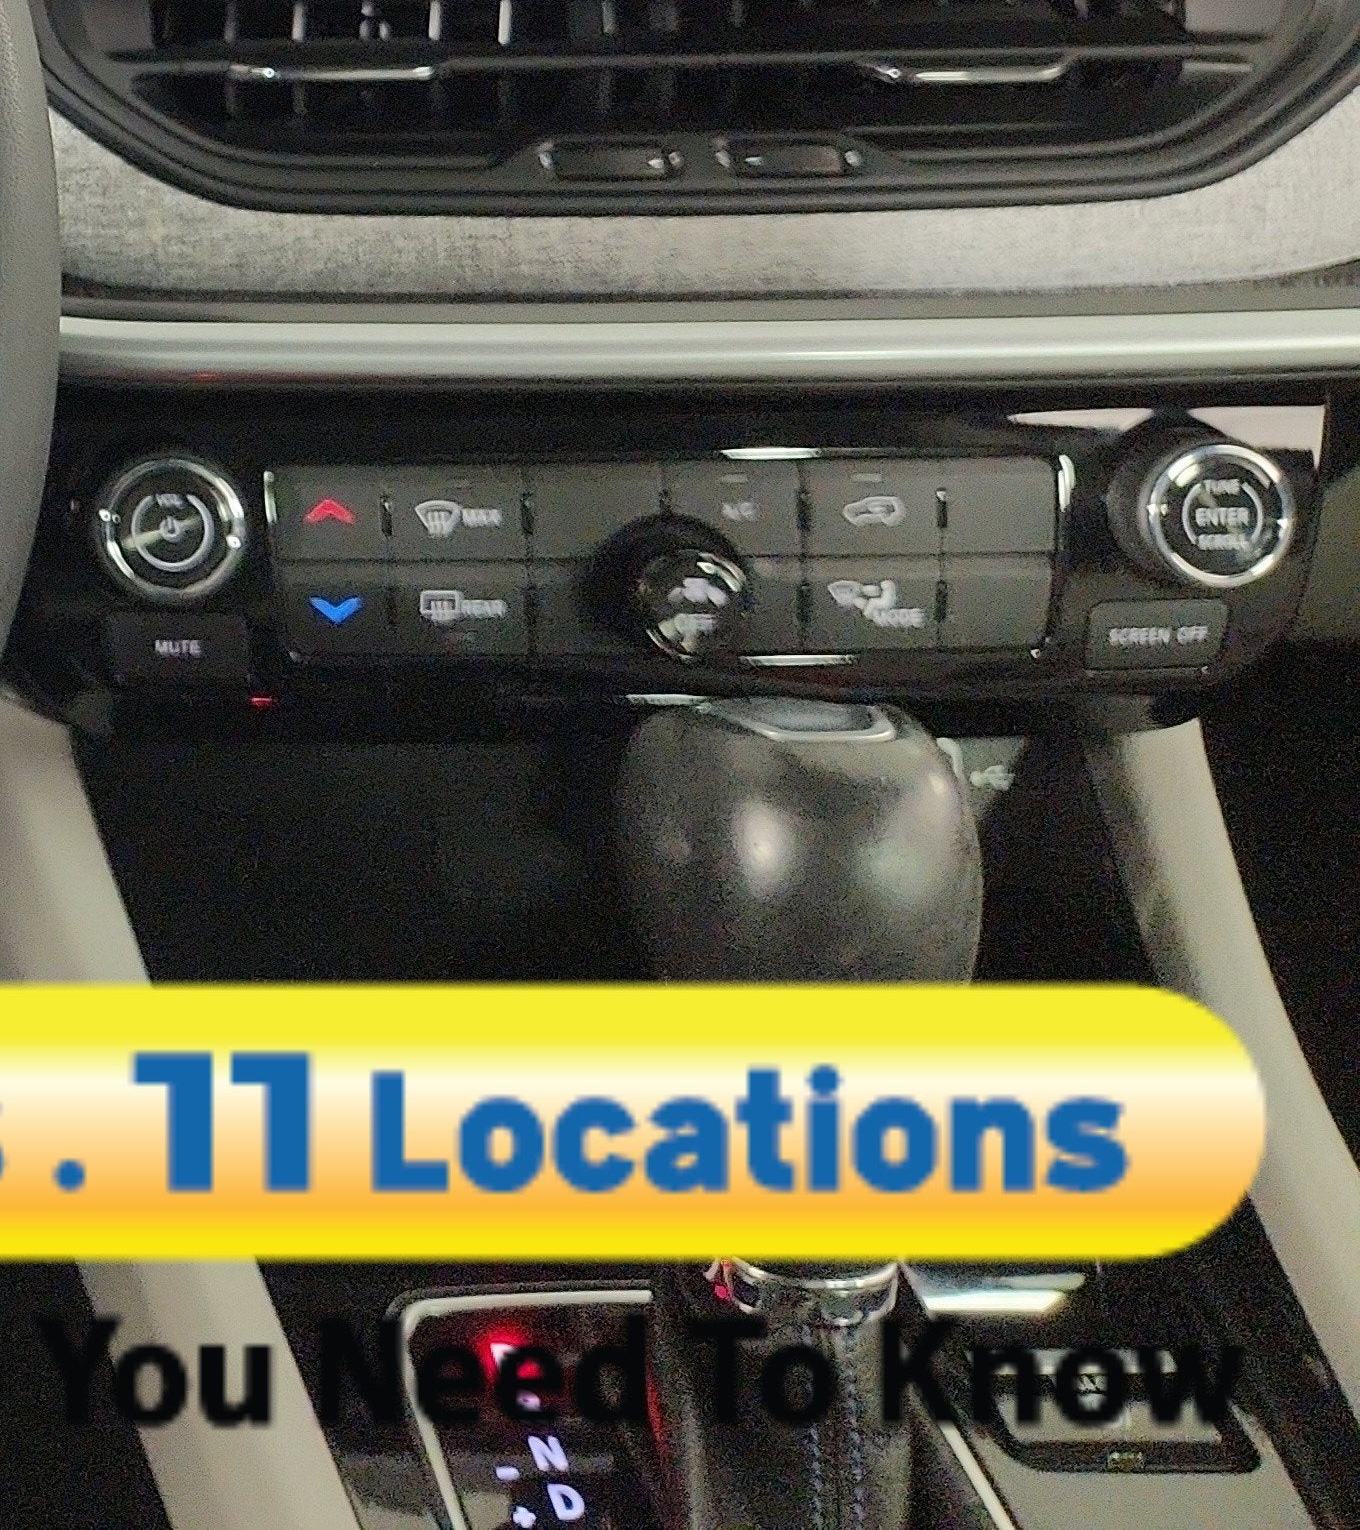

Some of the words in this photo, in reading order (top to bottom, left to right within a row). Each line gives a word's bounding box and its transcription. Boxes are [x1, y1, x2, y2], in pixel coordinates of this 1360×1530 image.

[1195, 507, 1250, 527] ENTER
[1109, 626, 1170, 646] SCREEN
[1177, 625, 1208, 645] OFF
[155, 639, 201, 657] MUTE
[527, 1435, 569, 1471] N
[547, 1483, 585, 1521] D
